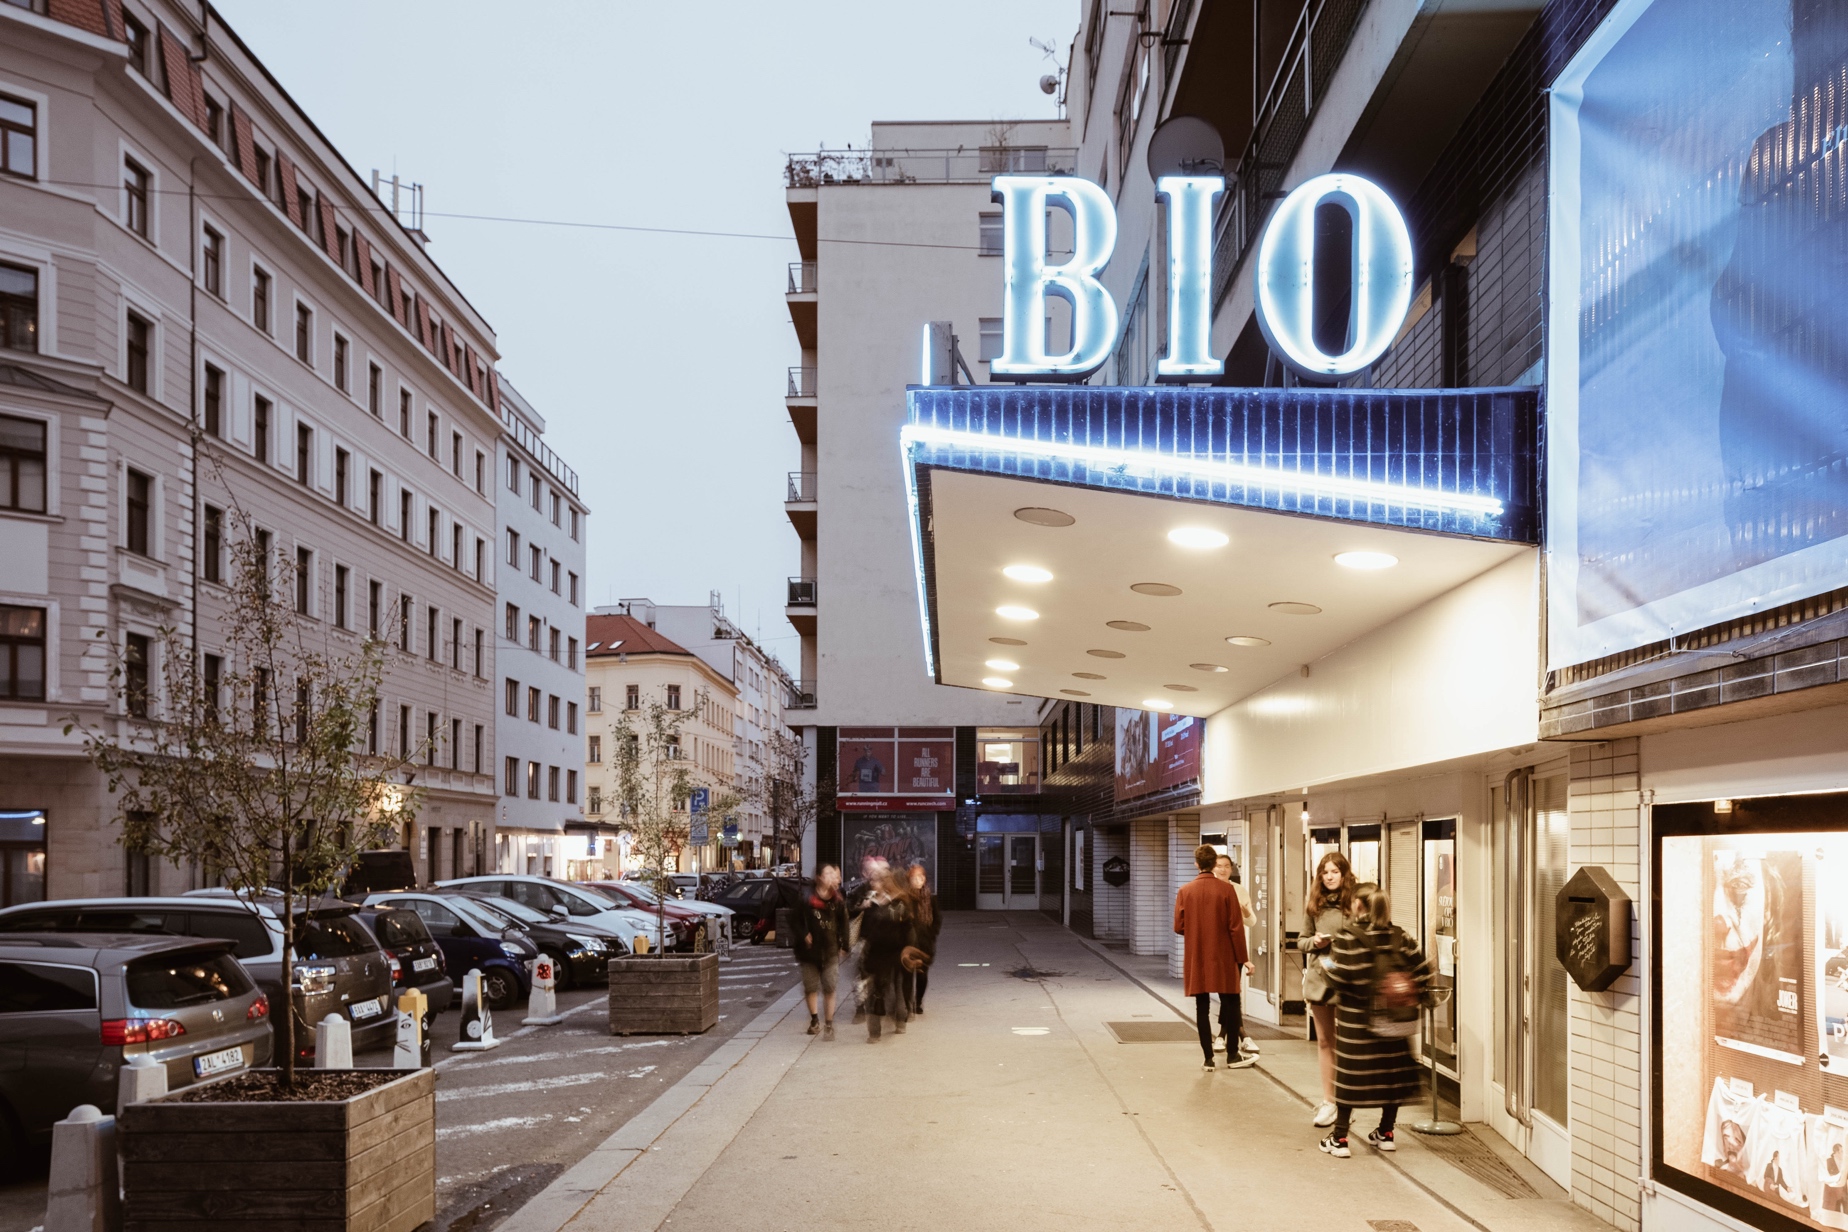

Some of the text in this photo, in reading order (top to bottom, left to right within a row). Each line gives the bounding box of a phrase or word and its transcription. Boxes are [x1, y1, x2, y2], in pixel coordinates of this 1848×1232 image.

[990, 173, 1414, 380] BIO
[922, 747, 930, 758] ALL
[913, 757, 938, 768] RUNNERS
[921, 767, 931, 778] ARE
[912, 777, 939, 788] BEAUTIFUL
[201, 1049, 240, 1071] 2AL 4182
